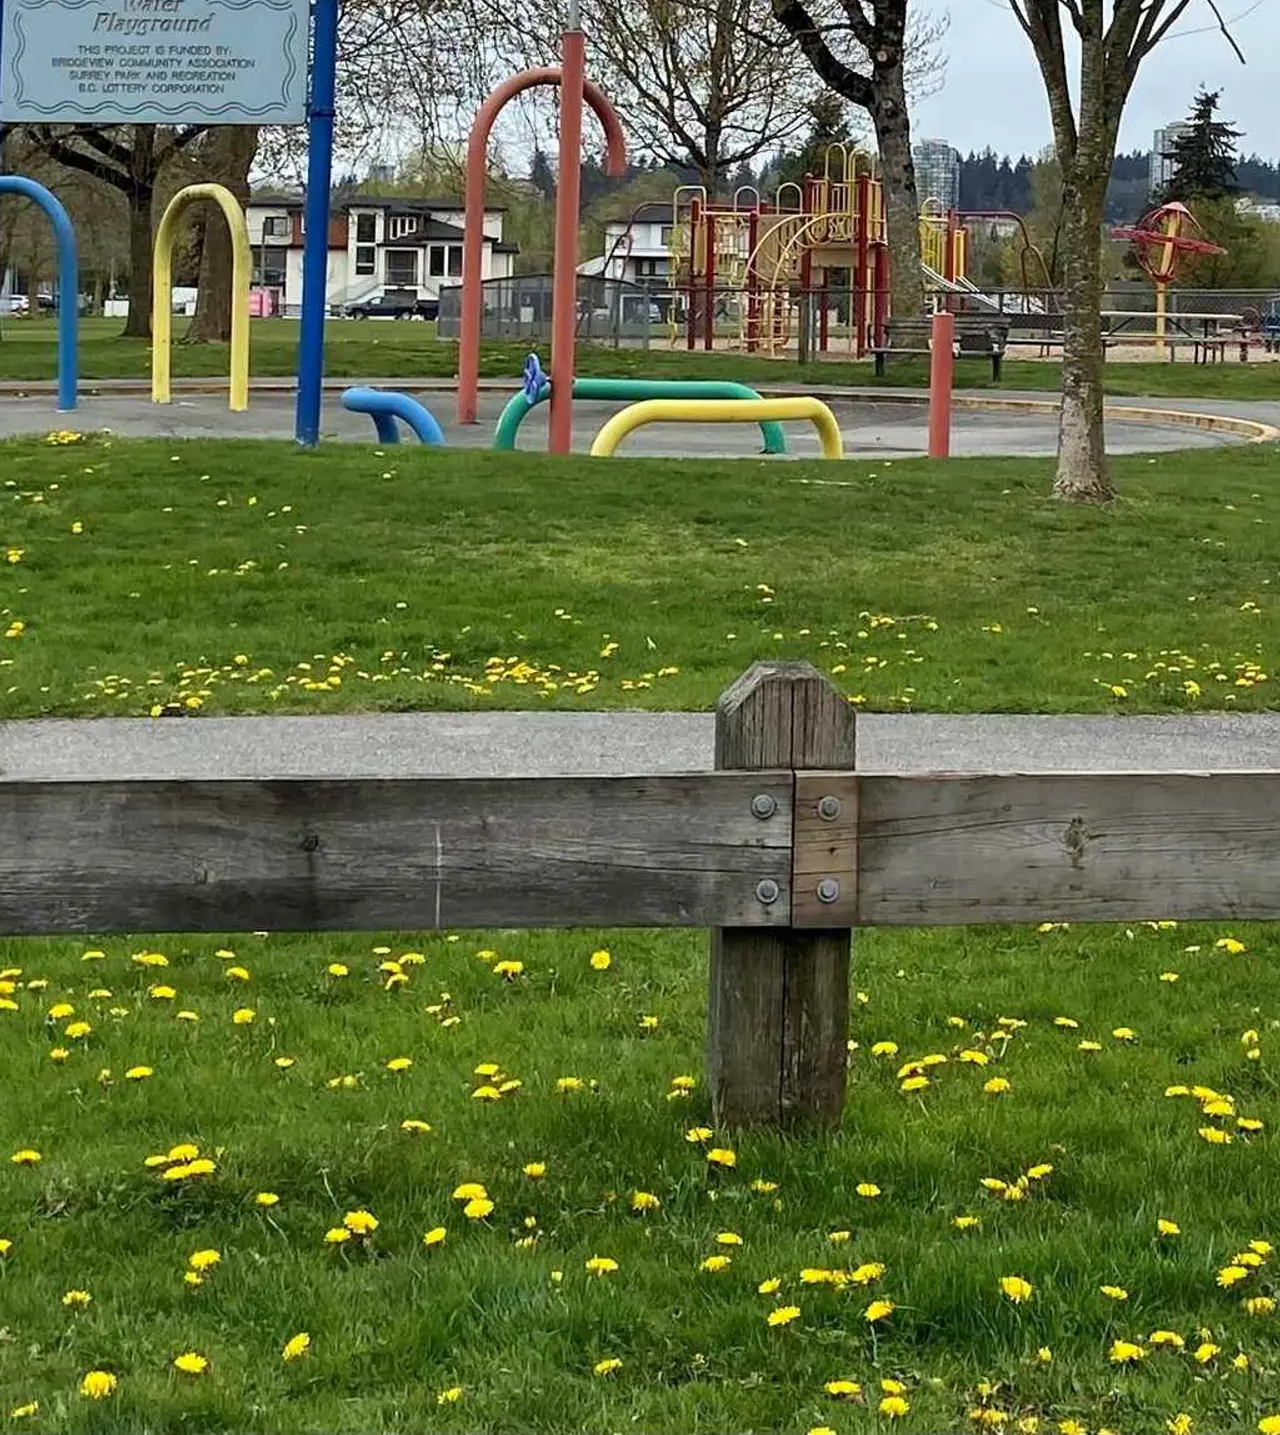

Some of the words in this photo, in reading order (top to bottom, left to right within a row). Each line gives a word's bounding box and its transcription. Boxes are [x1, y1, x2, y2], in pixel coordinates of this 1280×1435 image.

[92, 12, 216, 36] Playground
[78, 45, 101, 55] THIS
[104, 45, 150, 55] PROJECT
[155, 45, 165, 55] IS
[169, 45, 212, 55] FUNDED
[51, 58, 114, 68] BRIDGEVIEW
[119, 58, 182, 68] COMMUNITY
[187, 58, 255, 68] ASSOCIATION
[70, 70, 110, 81] SURREY
[115, 70, 141, 81] PARK
[146, 70, 167, 81] AND
[172, 70, 235, 81] RECREATION
[102, 83, 148, 94] LOTTERY
[151, 83, 224, 94] CORPORATION
